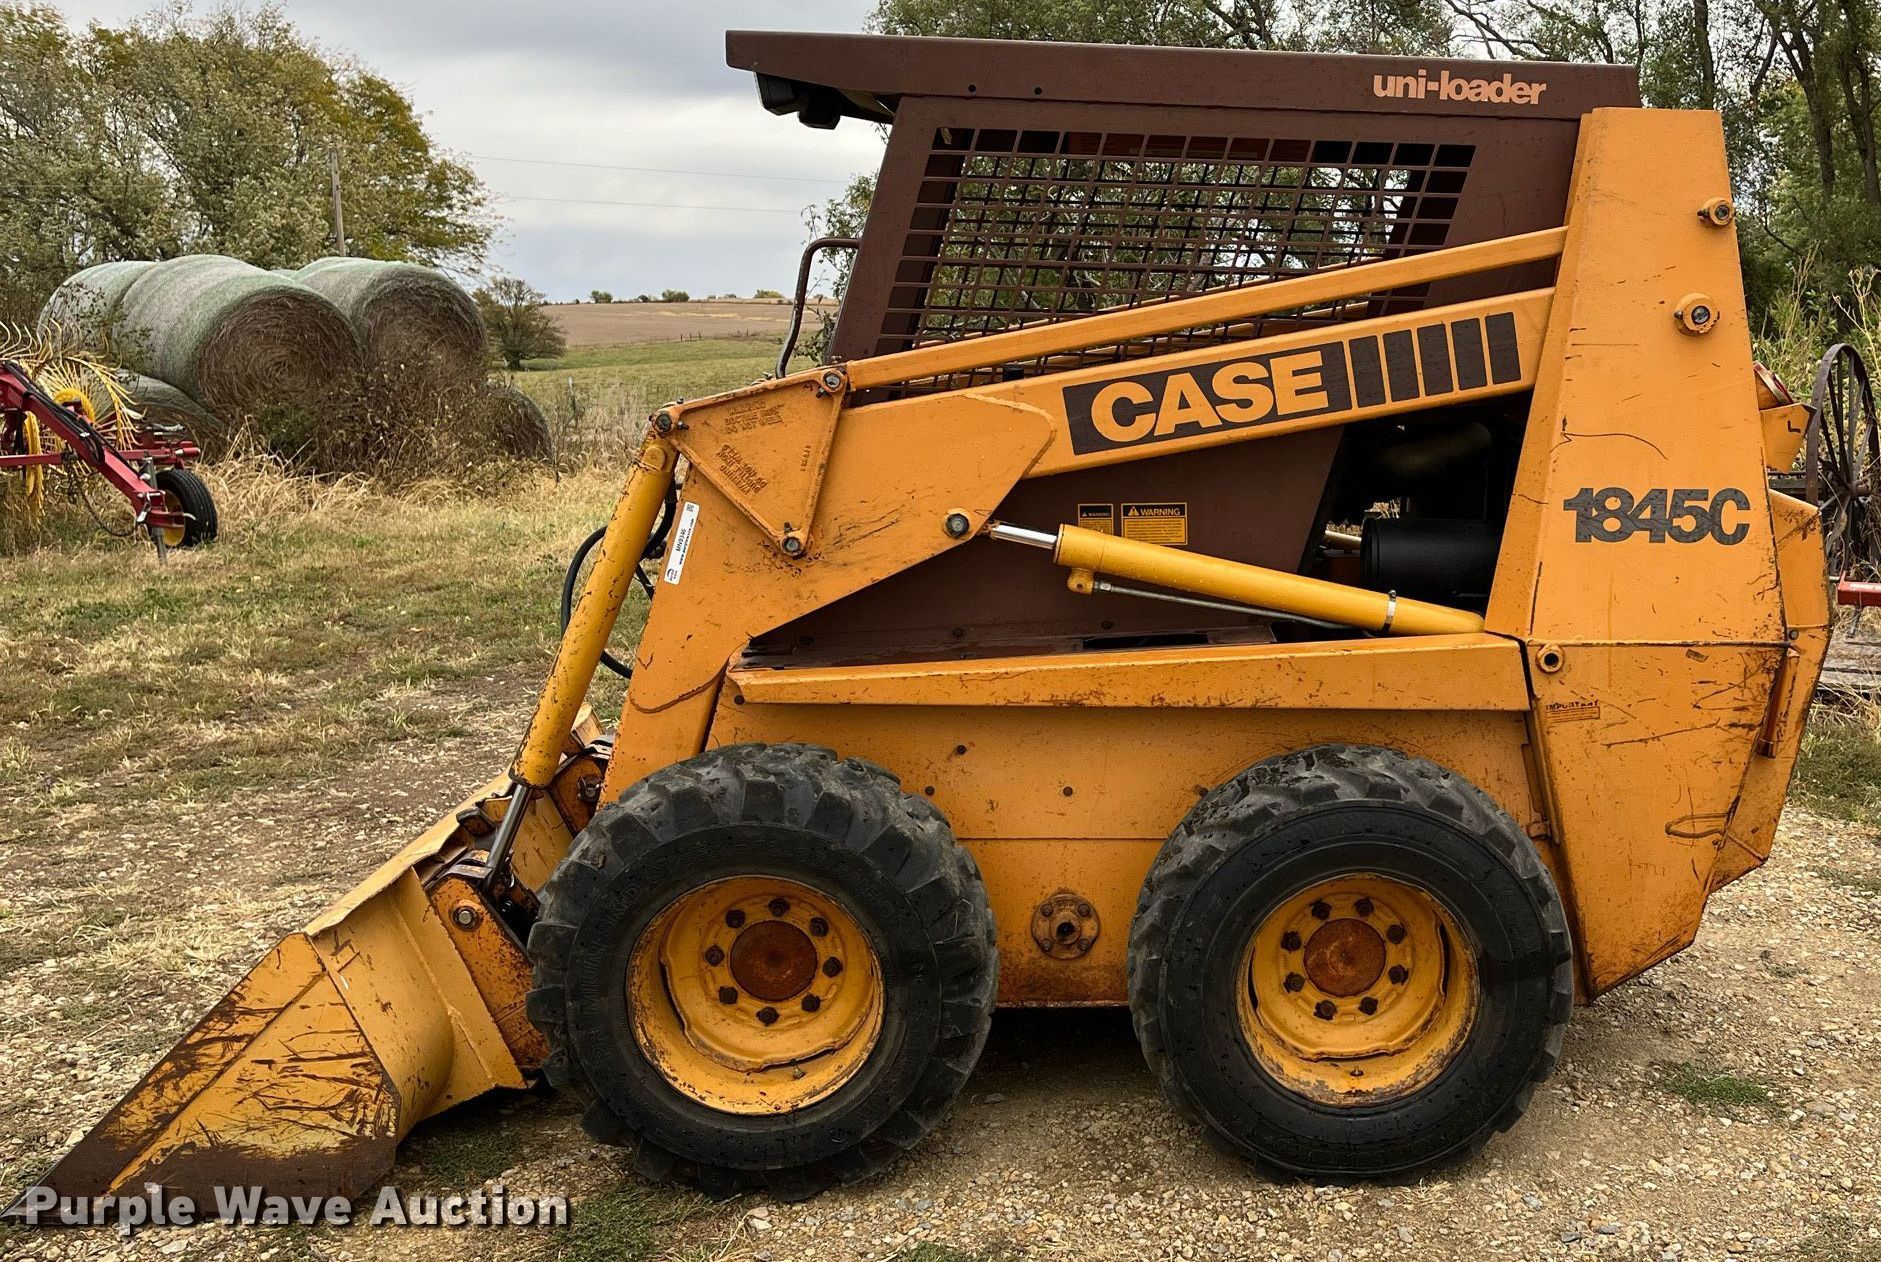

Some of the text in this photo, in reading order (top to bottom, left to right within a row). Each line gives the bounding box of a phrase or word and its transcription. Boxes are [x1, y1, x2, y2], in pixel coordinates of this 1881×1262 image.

[1373, 69, 1547, 104] uni-loader
[1091, 350, 1329, 444] CASE
[1140, 508, 1181, 516] WARNING
[1563, 487, 1750, 546] 1845C
